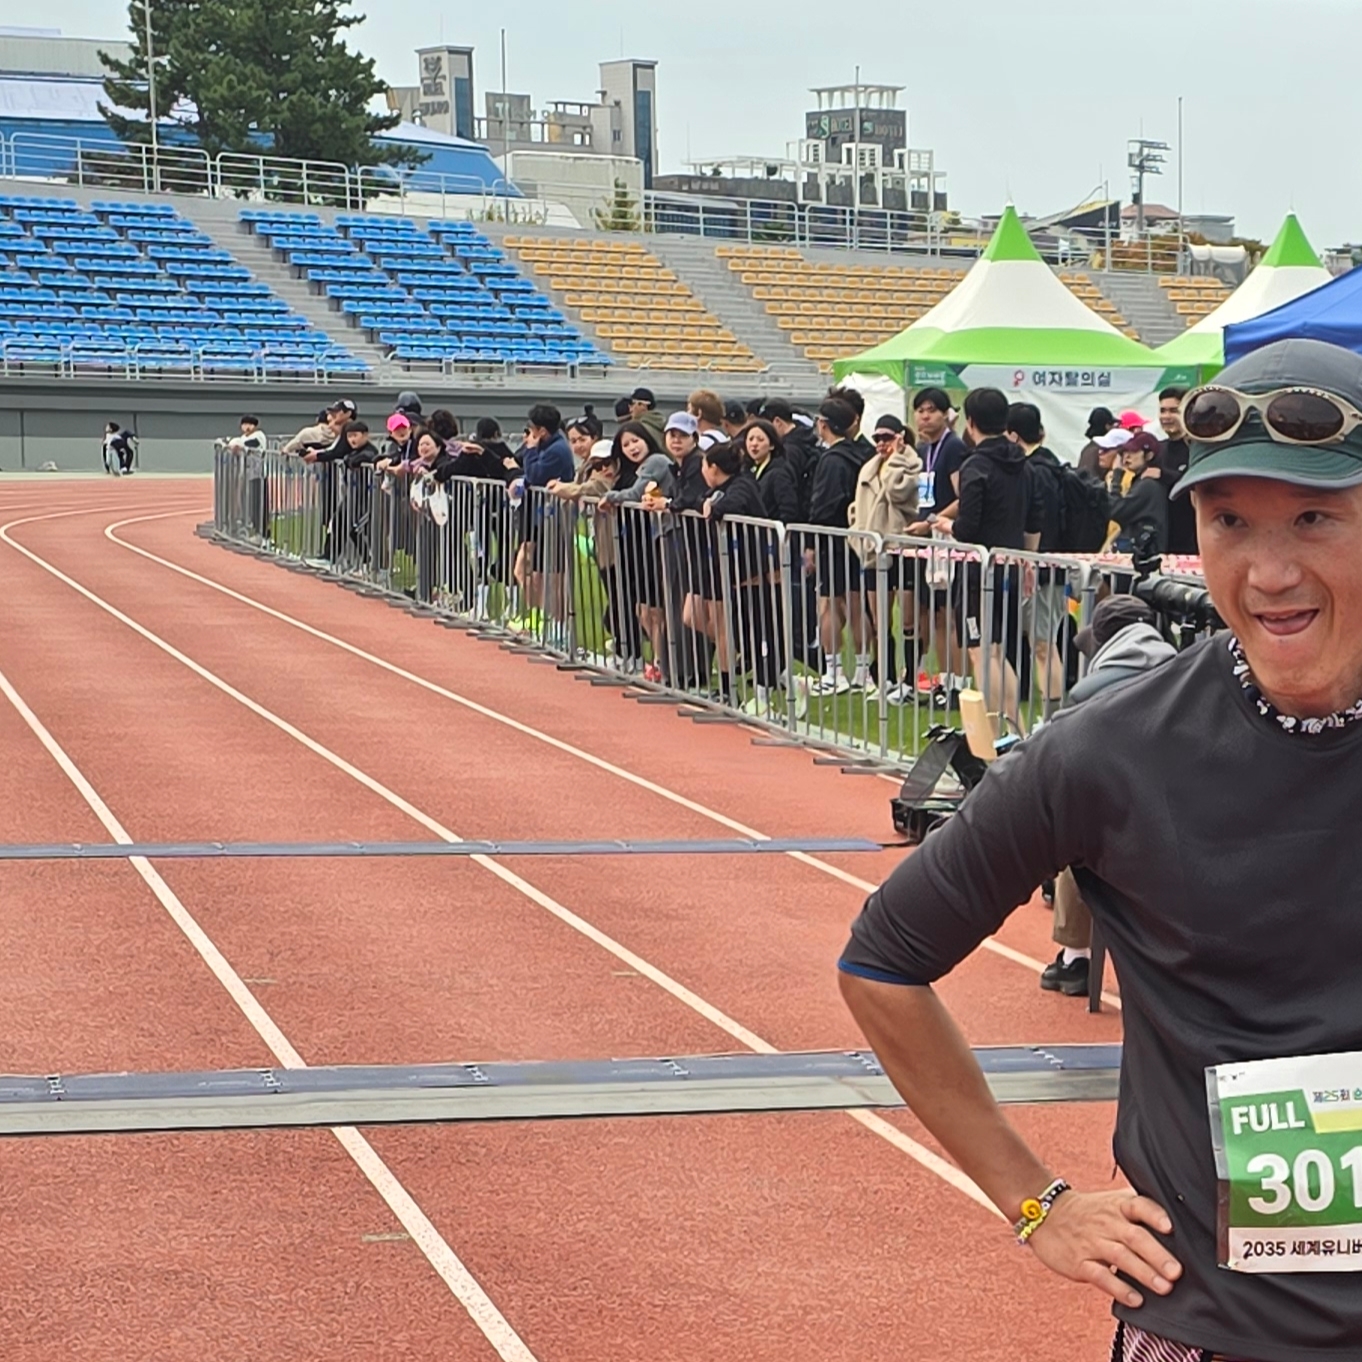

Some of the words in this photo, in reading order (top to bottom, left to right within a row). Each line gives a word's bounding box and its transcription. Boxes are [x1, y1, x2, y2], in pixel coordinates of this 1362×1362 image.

[1032, 370, 1111, 388] 여자탈의실
[1230, 1101, 1306, 1135] FULL
[1242, 1240, 1286, 1260] 2035
